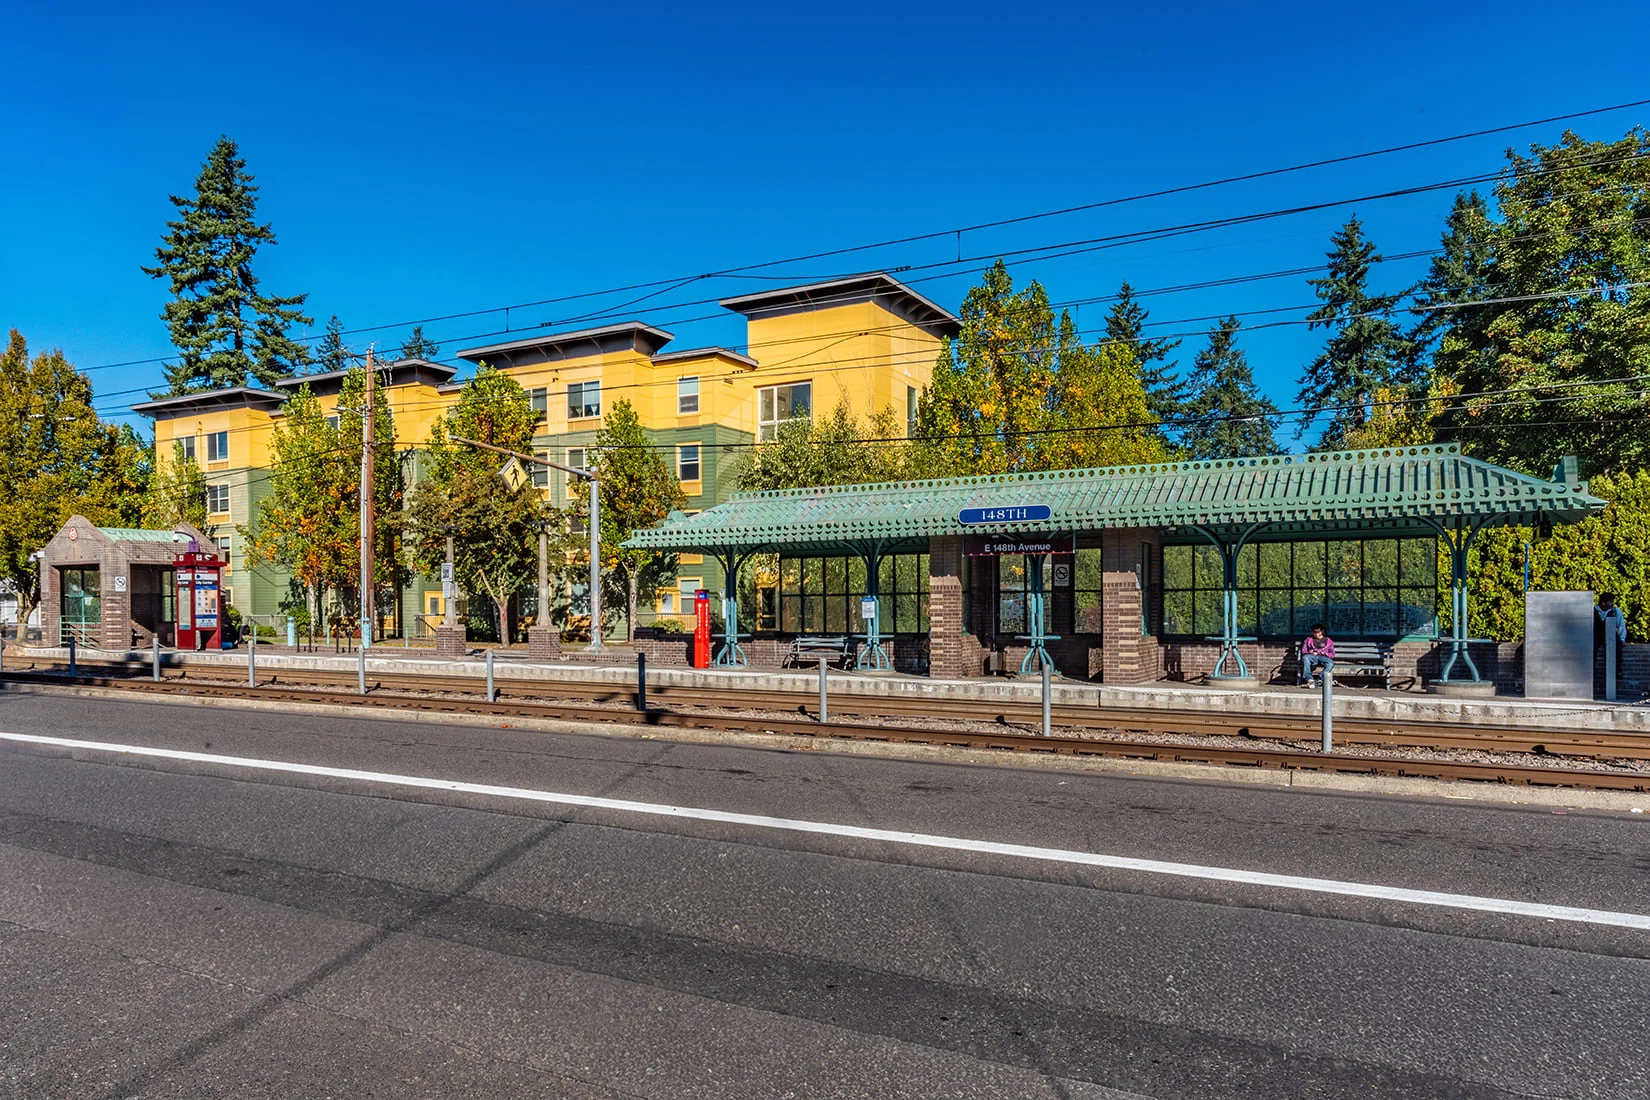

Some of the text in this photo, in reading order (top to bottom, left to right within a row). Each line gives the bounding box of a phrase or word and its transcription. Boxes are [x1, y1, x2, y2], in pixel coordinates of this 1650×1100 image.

[982, 508, 1027, 520] 148TH
[984, 543, 1051, 552] E 148th Avenue
